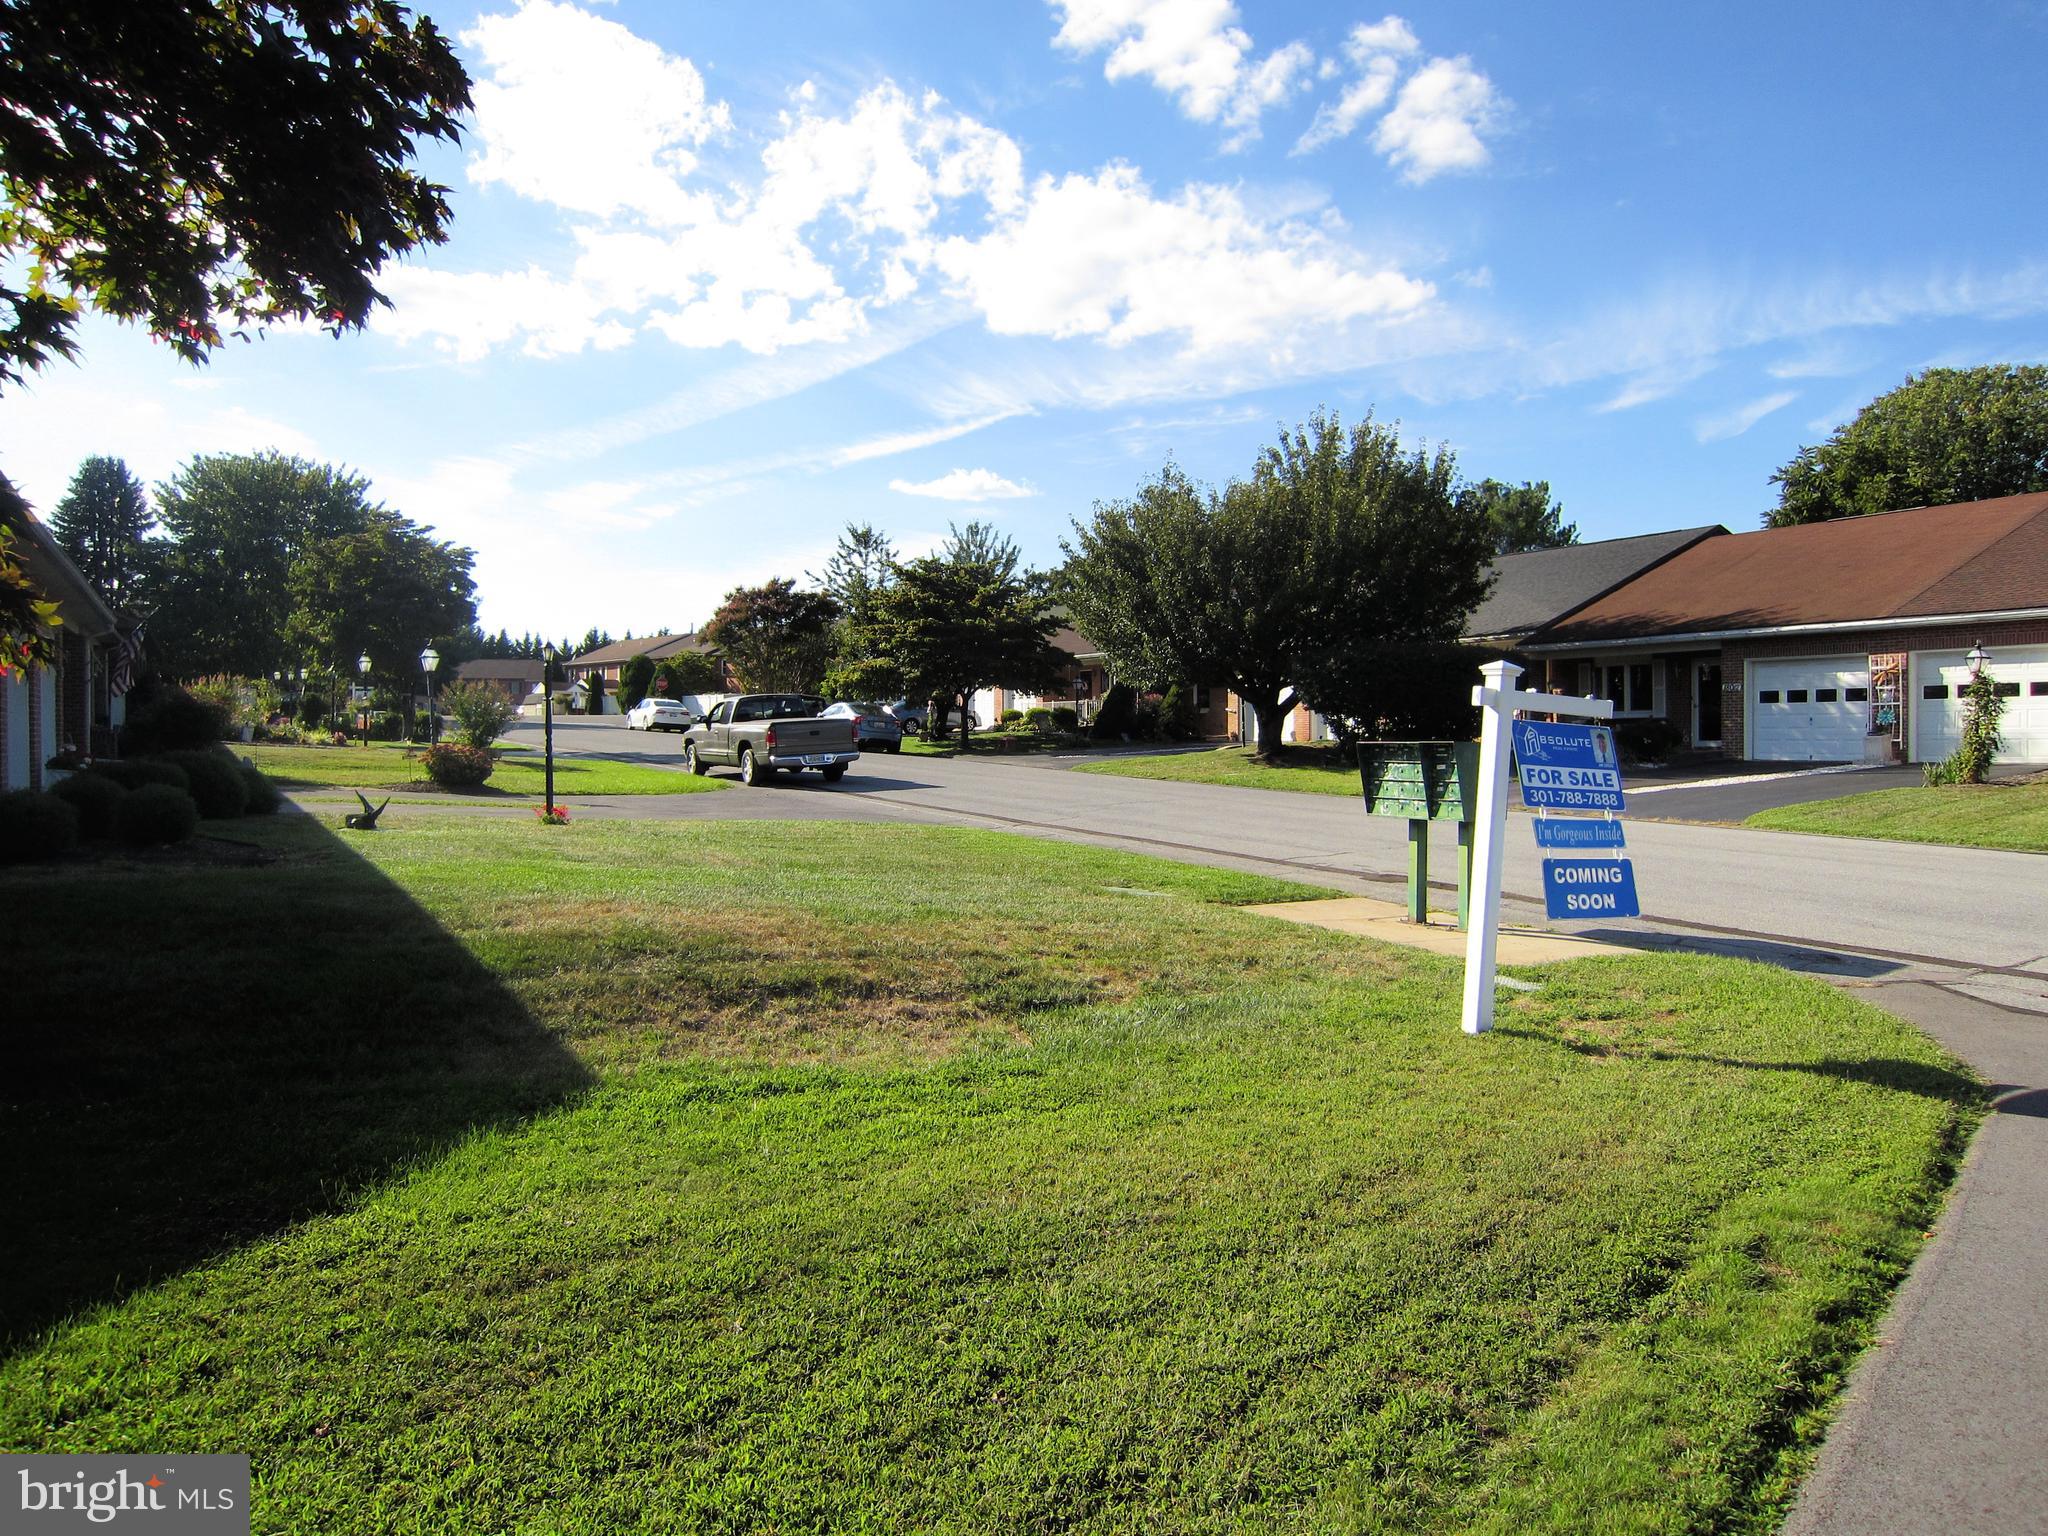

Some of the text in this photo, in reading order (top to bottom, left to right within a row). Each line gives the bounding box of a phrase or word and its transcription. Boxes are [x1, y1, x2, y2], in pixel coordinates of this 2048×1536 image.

[1526, 768, 1614, 788] FOR SALE
[1530, 790, 1618, 806] 301-788-7888
[1538, 824, 1621, 845] I'm Gorgeous Inside
[1554, 867, 1622, 884] COMING
[1567, 893, 1616, 910] SOON
